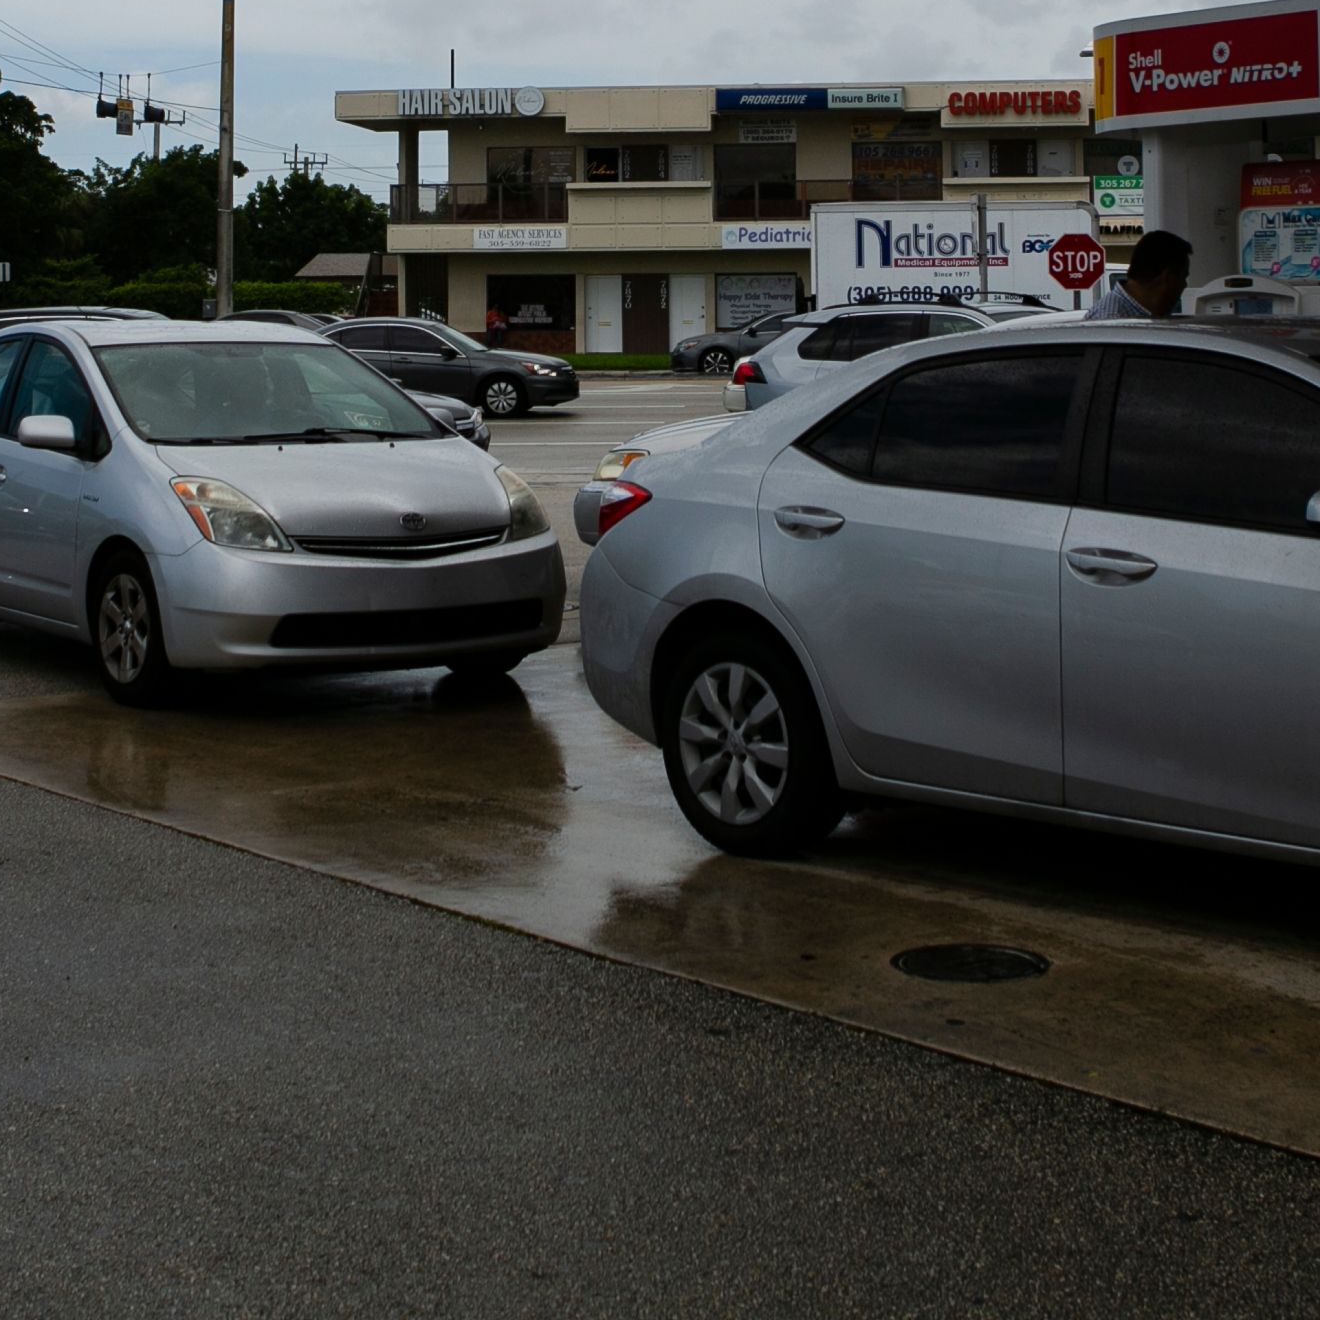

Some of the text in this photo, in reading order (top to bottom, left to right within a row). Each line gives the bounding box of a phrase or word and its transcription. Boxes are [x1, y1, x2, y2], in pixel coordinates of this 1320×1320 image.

[1128, 48, 1163, 70] Shell
[1129, 68, 1222, 95] V-Power
[397, 88, 444, 116] HAIR
[448, 87, 512, 116] SALON
[738, 94, 808, 105] PROGRESSIVE
[830, 93, 863, 104] Insure
[866, 93, 890, 104] Brite
[947, 90, 1082, 116] COMPUTERS
[1100, 179, 1118, 187] 305
[1120, 179, 1135, 187] 267
[1252, 177, 1272, 186] WIN
[497, 229, 525, 239] AGENCY
[527, 229, 562, 239] SERVICES
[855, 218, 1010, 269] National
[897, 257, 1006, 268] Medical Equipme Inc.
[1052, 251, 1102, 273] STOP
[719, 293, 743, 303] Happy
[762, 292, 793, 302] Therapy
